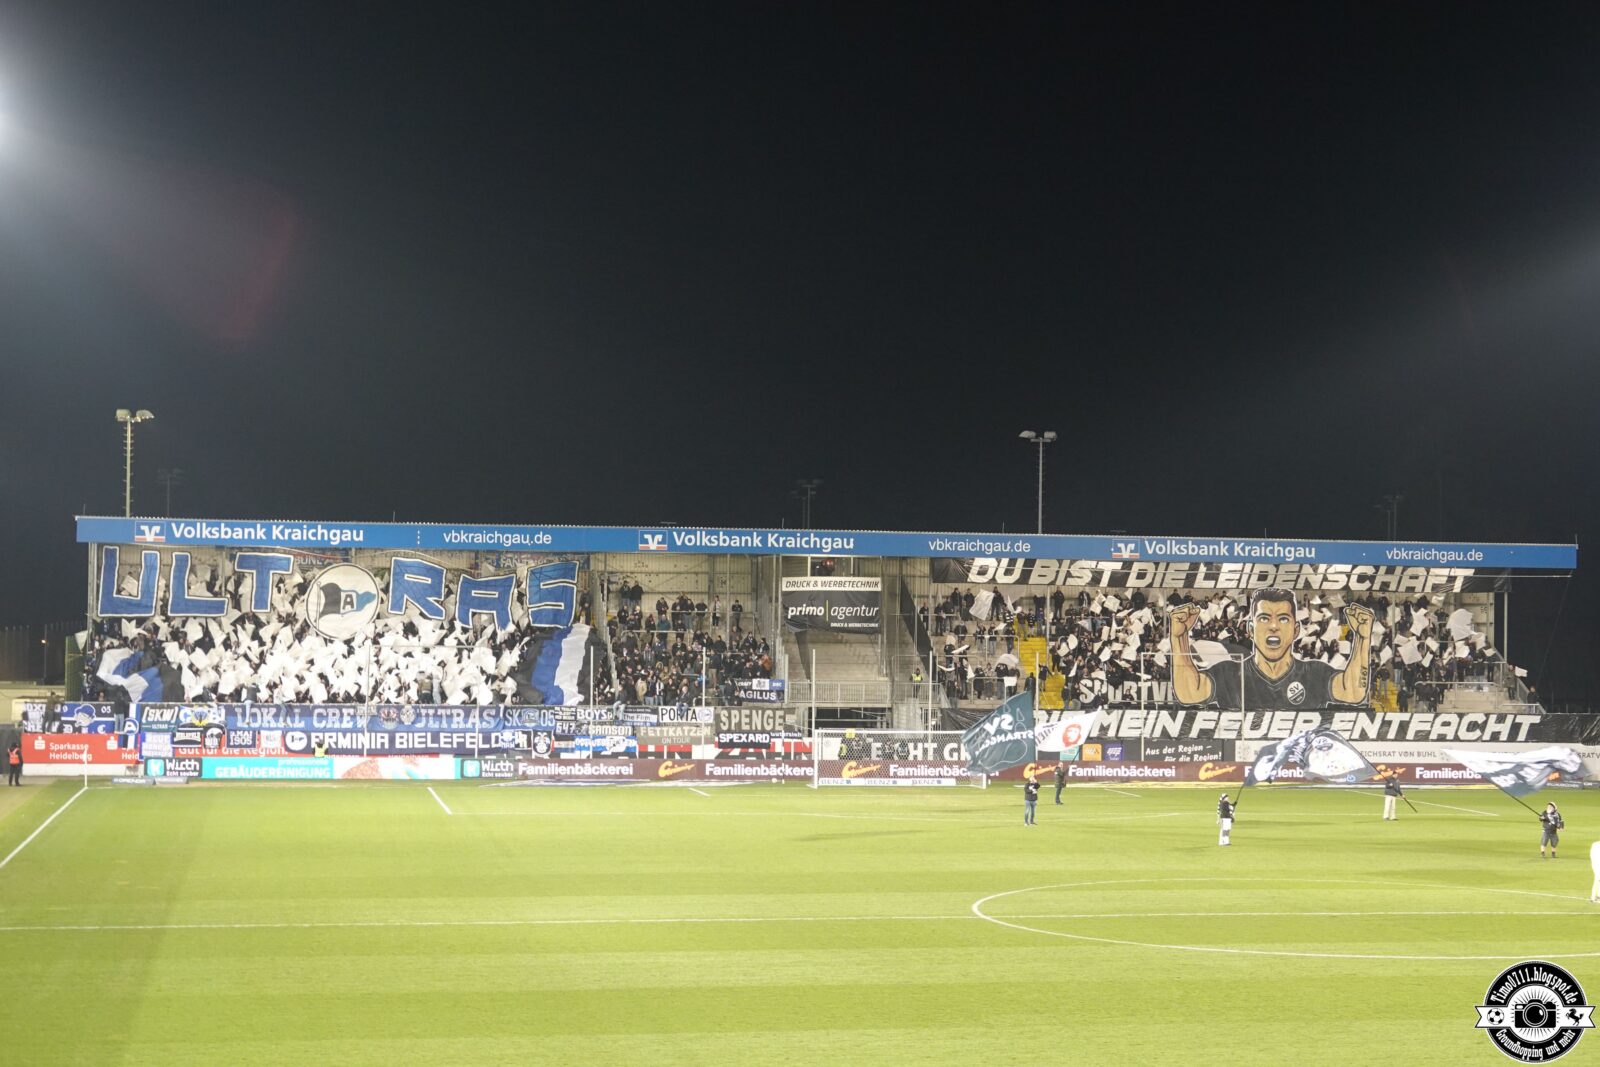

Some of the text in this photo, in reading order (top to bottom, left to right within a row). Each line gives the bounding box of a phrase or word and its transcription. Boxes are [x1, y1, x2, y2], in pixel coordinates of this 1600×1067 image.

[171, 522, 364, 545] Volksbank Kraichgau
[443, 530, 552, 546] vbkraichgau.de
[673, 531, 854, 552] Volksbank Kraichgau
[929, 538, 1031, 555] vbkraichgau.de
[1144, 540, 1315, 562] Volksbank Kraichgau
[1386, 548, 1483, 564] vbkraichgau.de
[967, 557, 1476, 594] DU BIST DIE LEIDENSCHAFT
[785, 580, 811, 589] DRUCK
[820, 580, 880, 589] WERBETECHNIK
[788, 603, 879, 620] primo agentur
[739, 690, 777, 701] AGILUS
[1288, 683, 1300, 695] SV
[100, 705, 112, 714] 05
[540, 709, 556, 727] 05
[720, 709, 785, 731] SPENGE
[640, 726, 711, 737] FETTKATZEN
[1089, 709, 1187, 739] MEIN
[1188, 710, 1322, 740] FEUER
[1329, 711, 1542, 742] ENTFACHT
[719, 732, 770, 743] SPEXARD
[49, 742, 89, 751] Sparkasse
[1145, 744, 1204, 756] Aus der Region
[49, 752, 92, 761] Heidelbg
[215, 764, 330, 778] GEBÄUDEREINIGUNG
[518, 763, 634, 776] Familienbäckerei
[1068, 765, 1176, 777] Familienbäckerei
